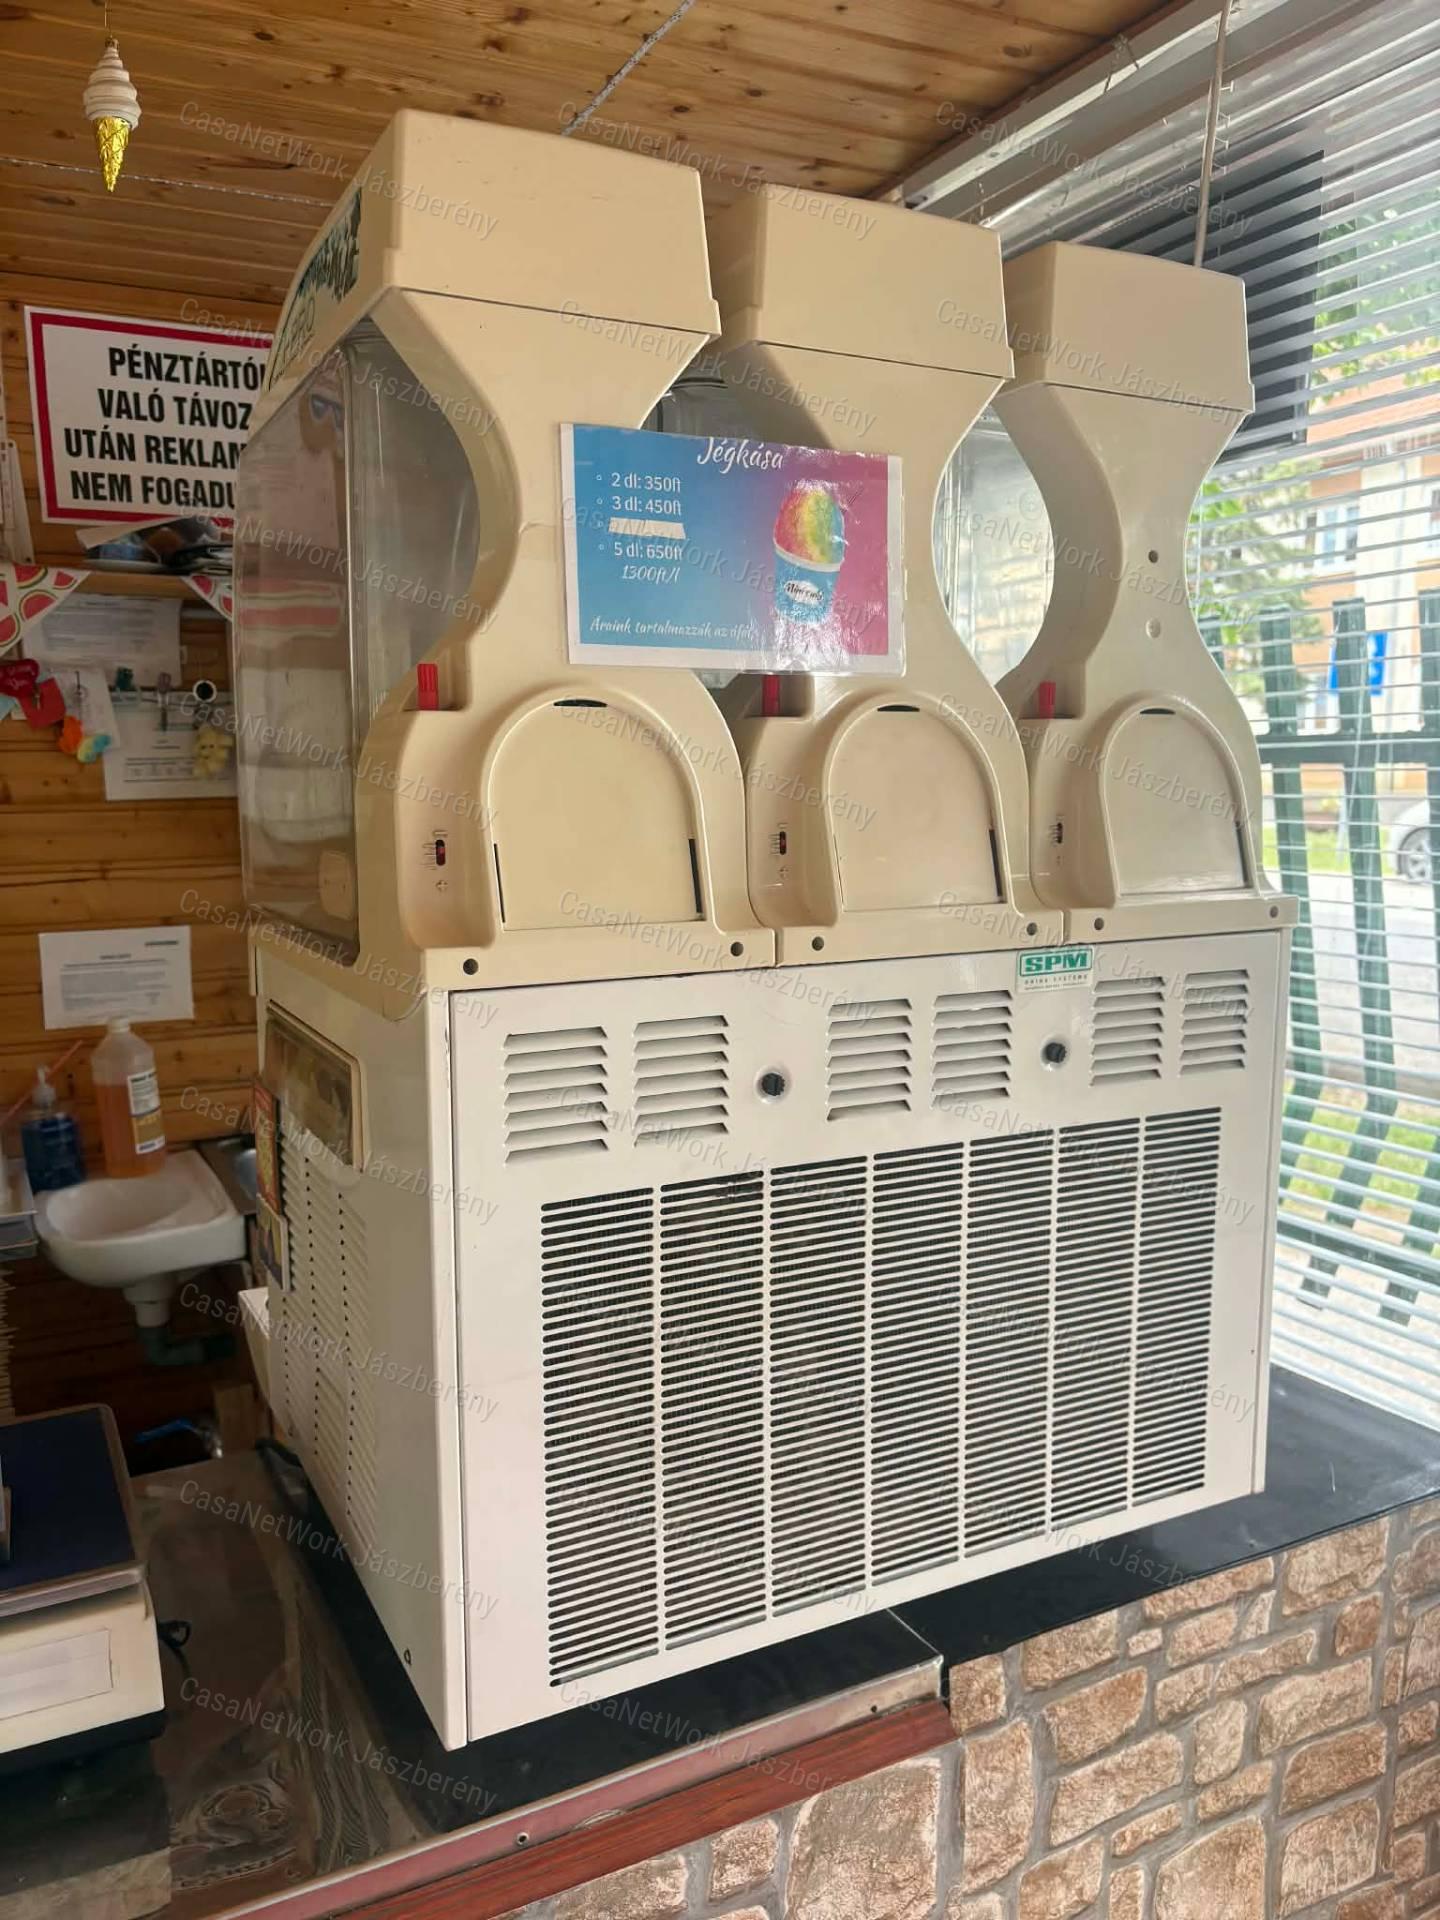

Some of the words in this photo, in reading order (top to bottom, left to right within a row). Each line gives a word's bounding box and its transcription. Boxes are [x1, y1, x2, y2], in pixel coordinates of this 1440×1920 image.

[97, 387, 165, 423] VALÓ
[173, 392, 252, 431] TÁVOZ
[64, 424, 136, 462] UTÁN
[697, 436, 783, 474] Jégkása
[70, 470, 133, 503] NEM
[611, 472, 621, 488] 2
[624, 473, 642, 489] dl:
[644, 475, 681, 493] 350ft
[612, 495, 622, 511] 3
[625, 496, 643, 513] dl:
[645, 499, 682, 516] 450ft
[615, 541, 623, 556] 5
[626, 542, 644, 559] dl:
[646, 544, 682, 561] 650ft
[1025, 952, 1088, 972] SPM
